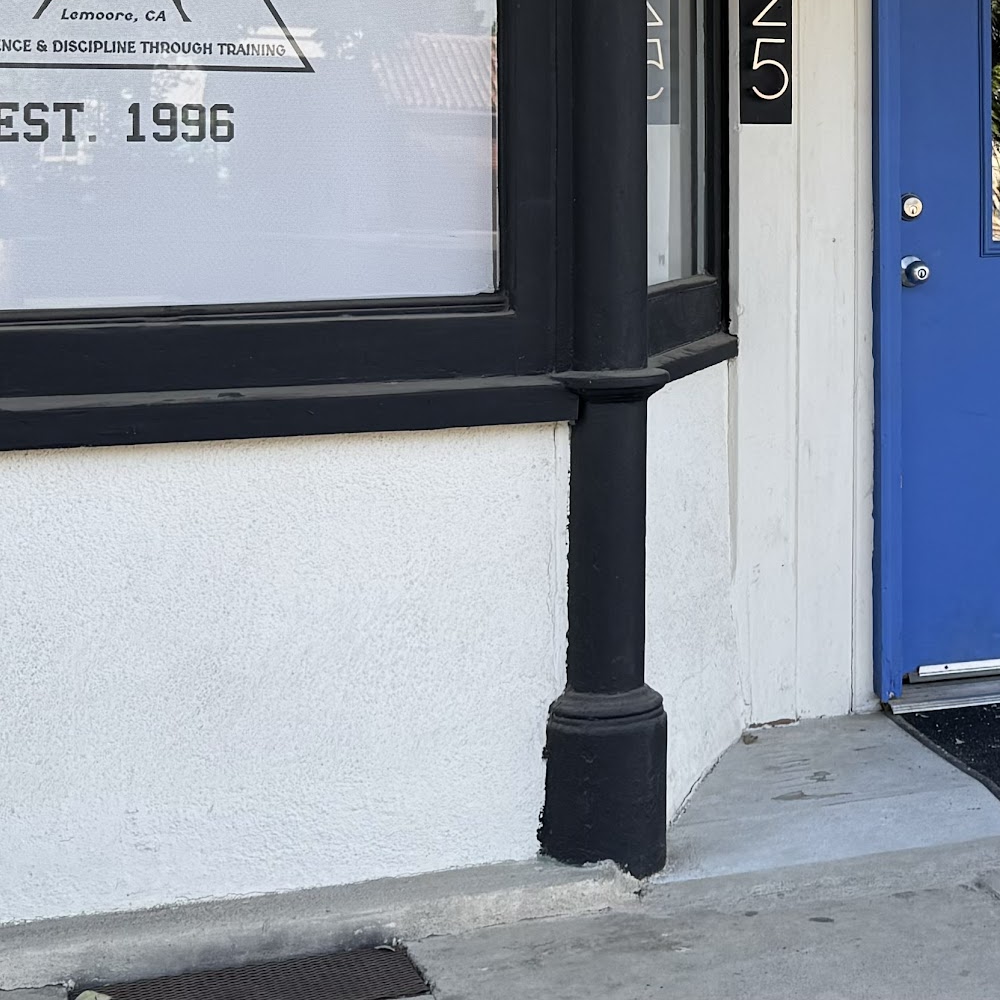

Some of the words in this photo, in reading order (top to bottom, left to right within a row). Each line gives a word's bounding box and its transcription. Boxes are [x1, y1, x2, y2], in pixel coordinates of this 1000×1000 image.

[61, 8, 138, 22] Lemoore,
[145, 10, 167, 22] CA
[0, 39, 32, 52] NCE
[36, 40, 48, 52] &
[52, 40, 136, 53] DISCIPLINE
[140, 41, 213, 55] THROUGH
[217, 43, 286, 56] TRAINING
[0, 102, 97, 142] EST.
[127, 102, 235, 143] 1996
